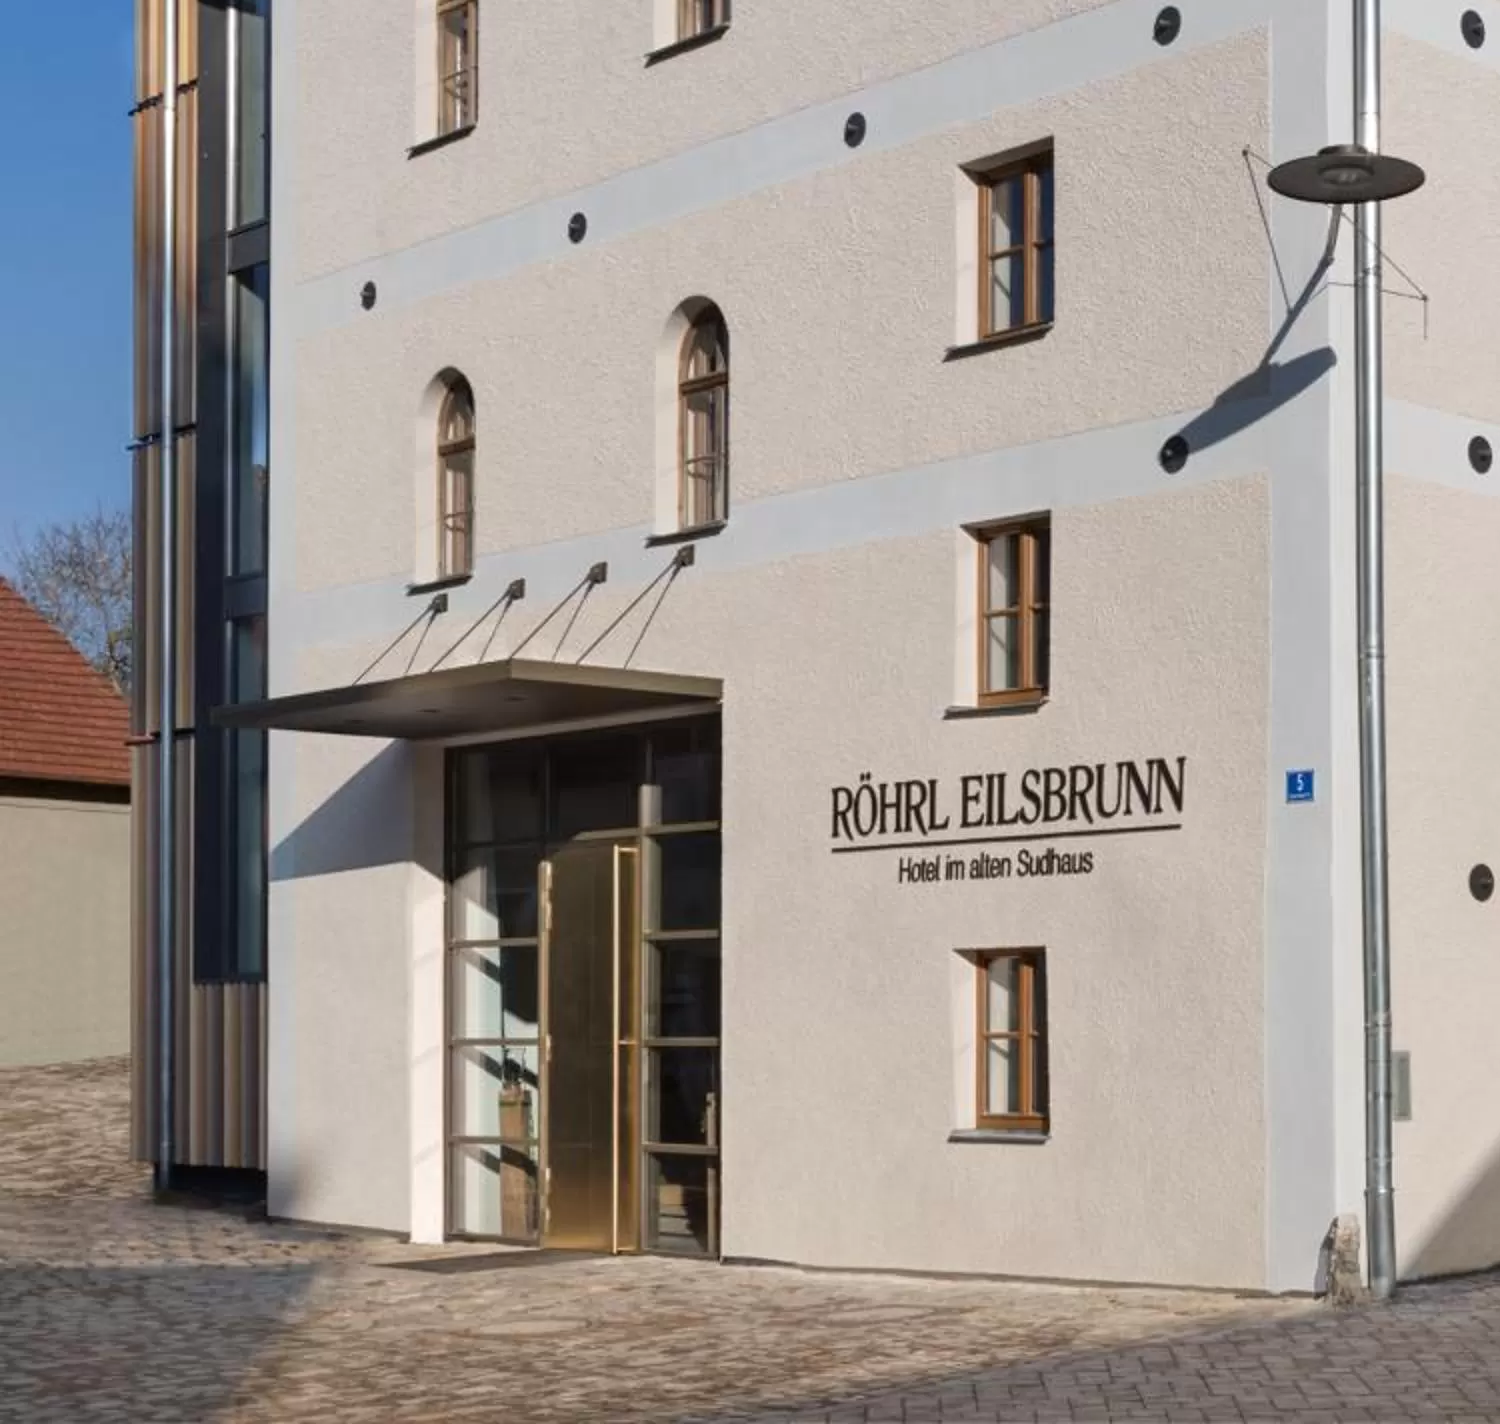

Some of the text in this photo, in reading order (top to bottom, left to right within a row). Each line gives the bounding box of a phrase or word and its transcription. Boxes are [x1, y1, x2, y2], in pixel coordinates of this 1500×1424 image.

[831, 756, 1186, 841] RÖHRL EILSBRUNN
[1296, 773, 1305, 791] 5
[899, 847, 1094, 883] Hotel im alten Sudhaus
